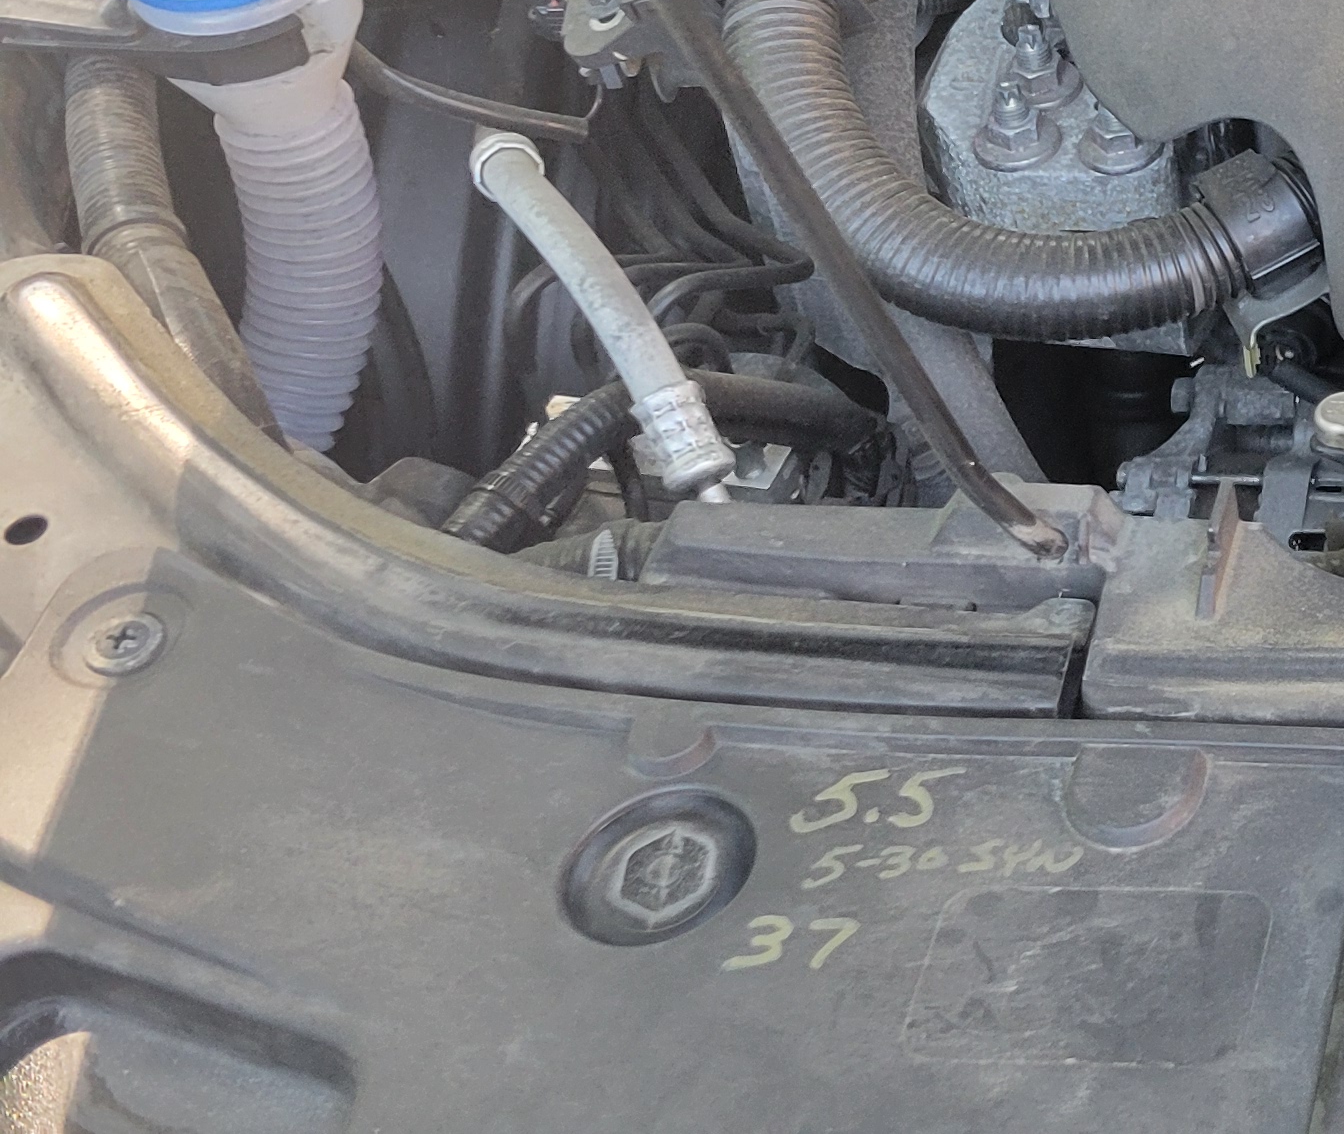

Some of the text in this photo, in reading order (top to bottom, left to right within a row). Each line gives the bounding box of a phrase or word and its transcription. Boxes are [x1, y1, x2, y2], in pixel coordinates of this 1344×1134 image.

[789, 766, 968, 834] 5.5
[801, 843, 948, 890] 5-30
[720, 914, 862, 973] 37
